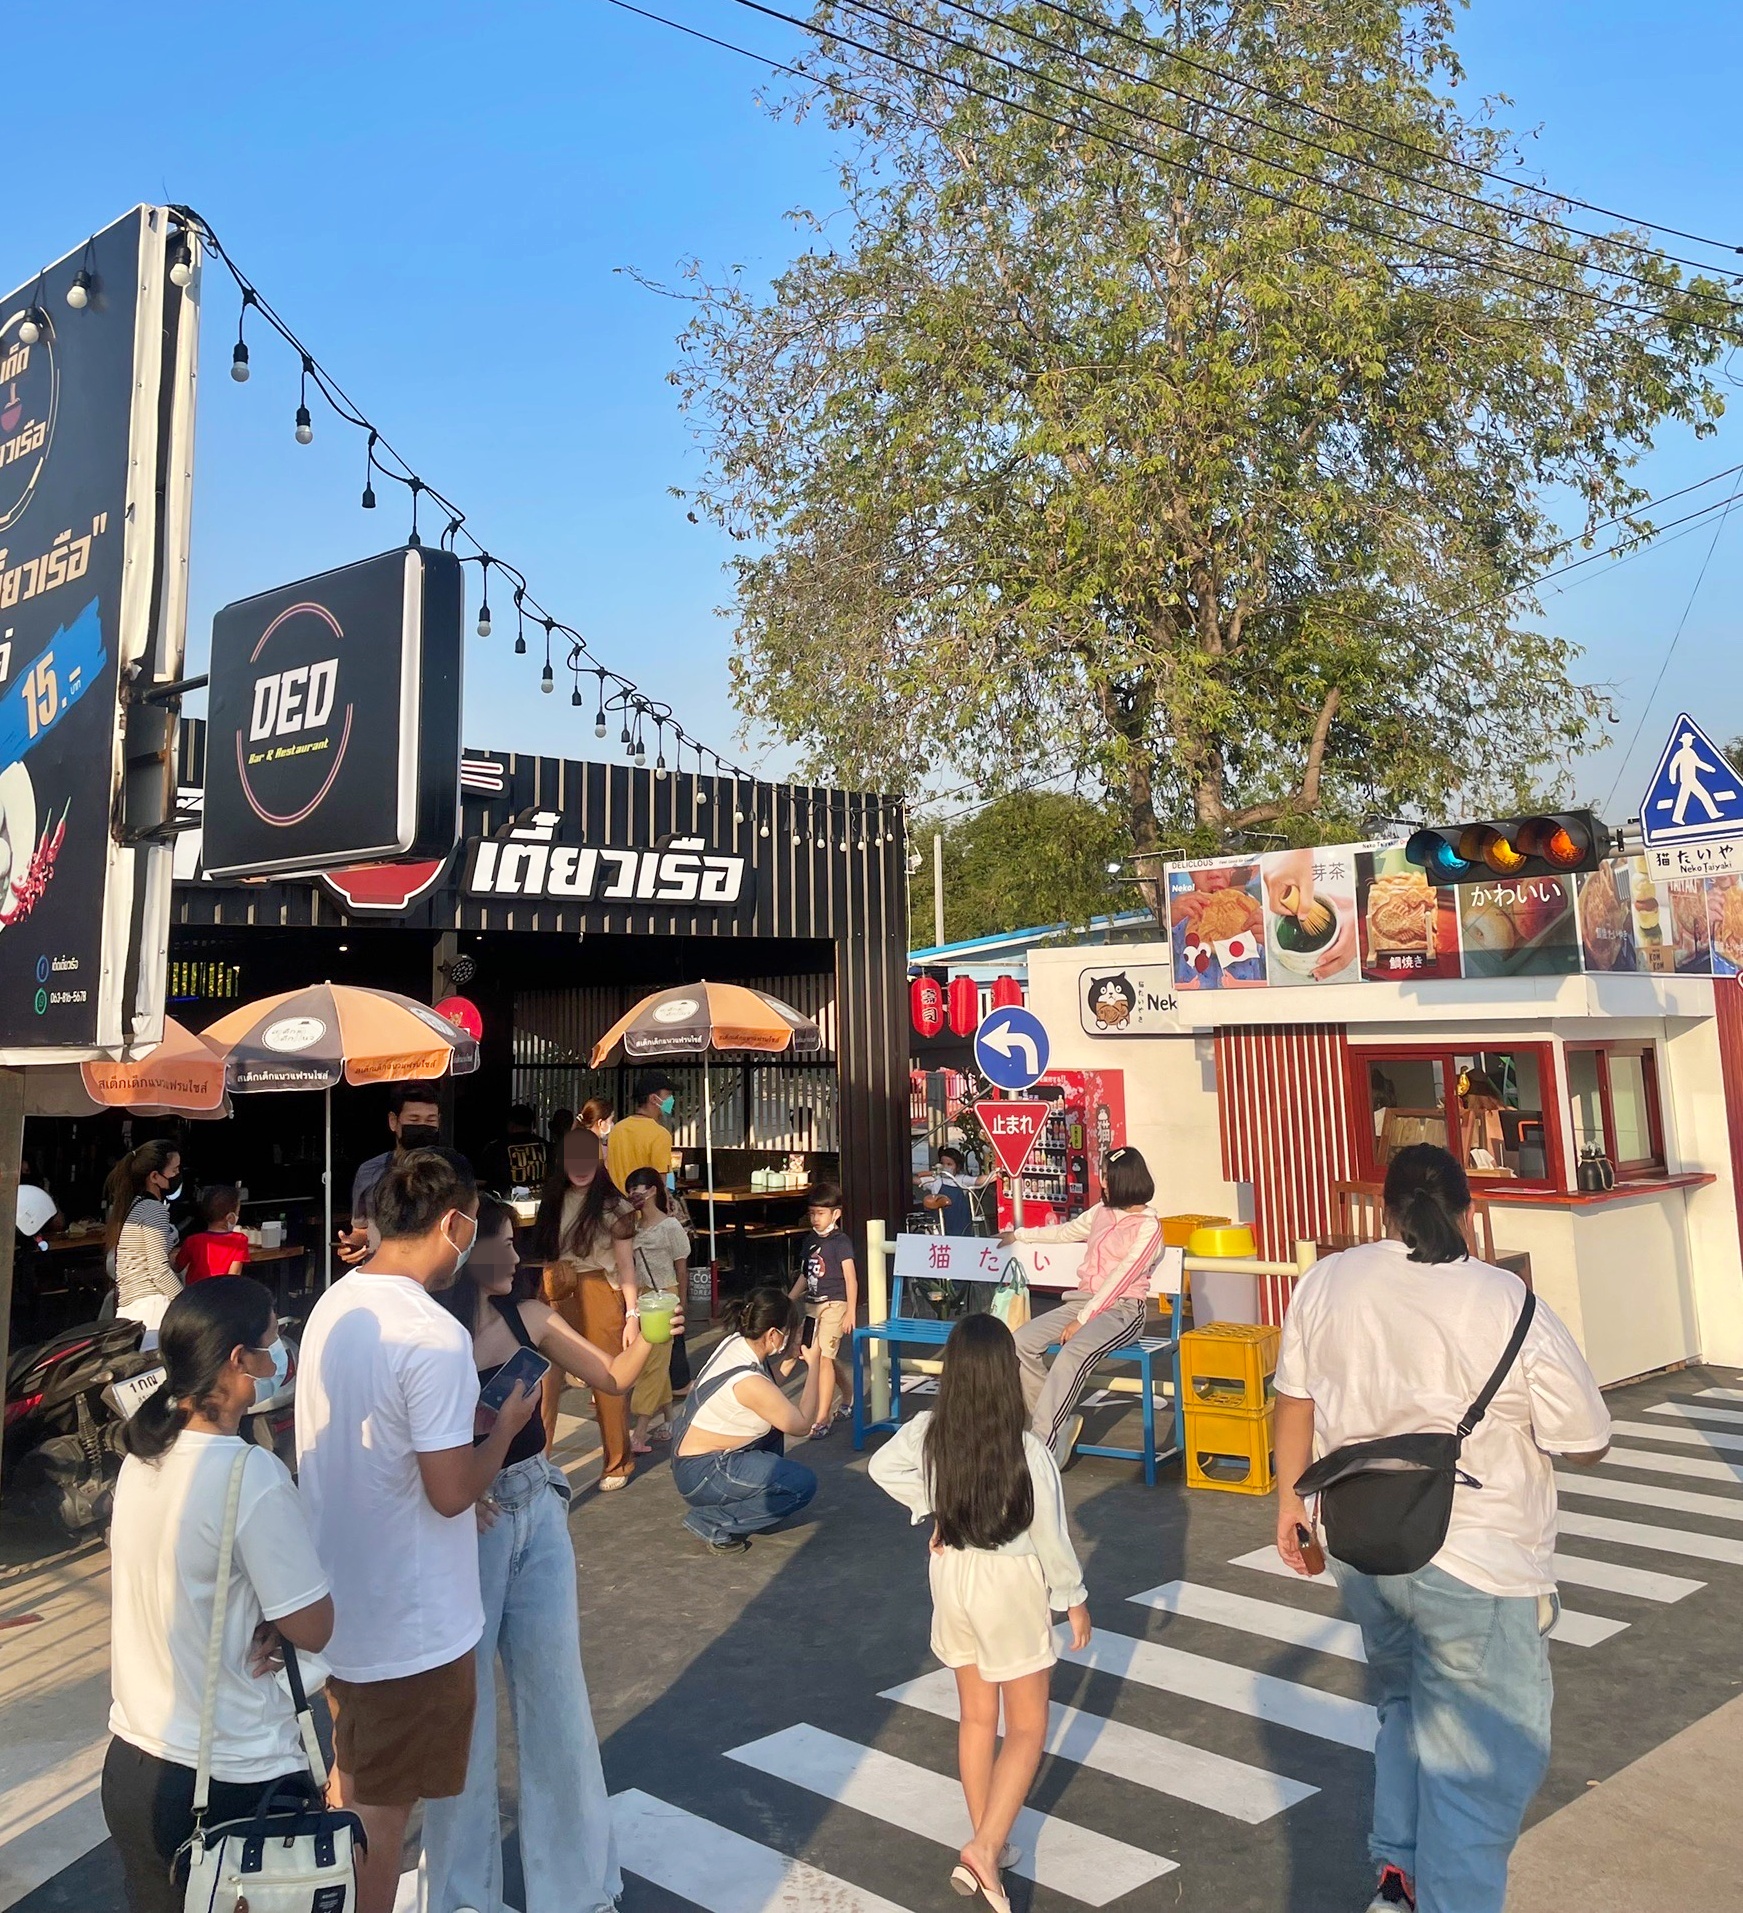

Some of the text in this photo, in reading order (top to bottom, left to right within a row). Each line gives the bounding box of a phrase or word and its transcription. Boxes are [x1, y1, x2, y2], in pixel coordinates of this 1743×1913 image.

[249, 658, 339, 742] DED
[248, 737, 329, 764] Bar & Restaurant
[471, 811, 745, 902] เตี๋ยวเรือ
[1656, 844, 1734, 866] 猫たいや
[1471, 883, 1561, 907] かわいい
[992, 1114, 1034, 1135] 止まれ
